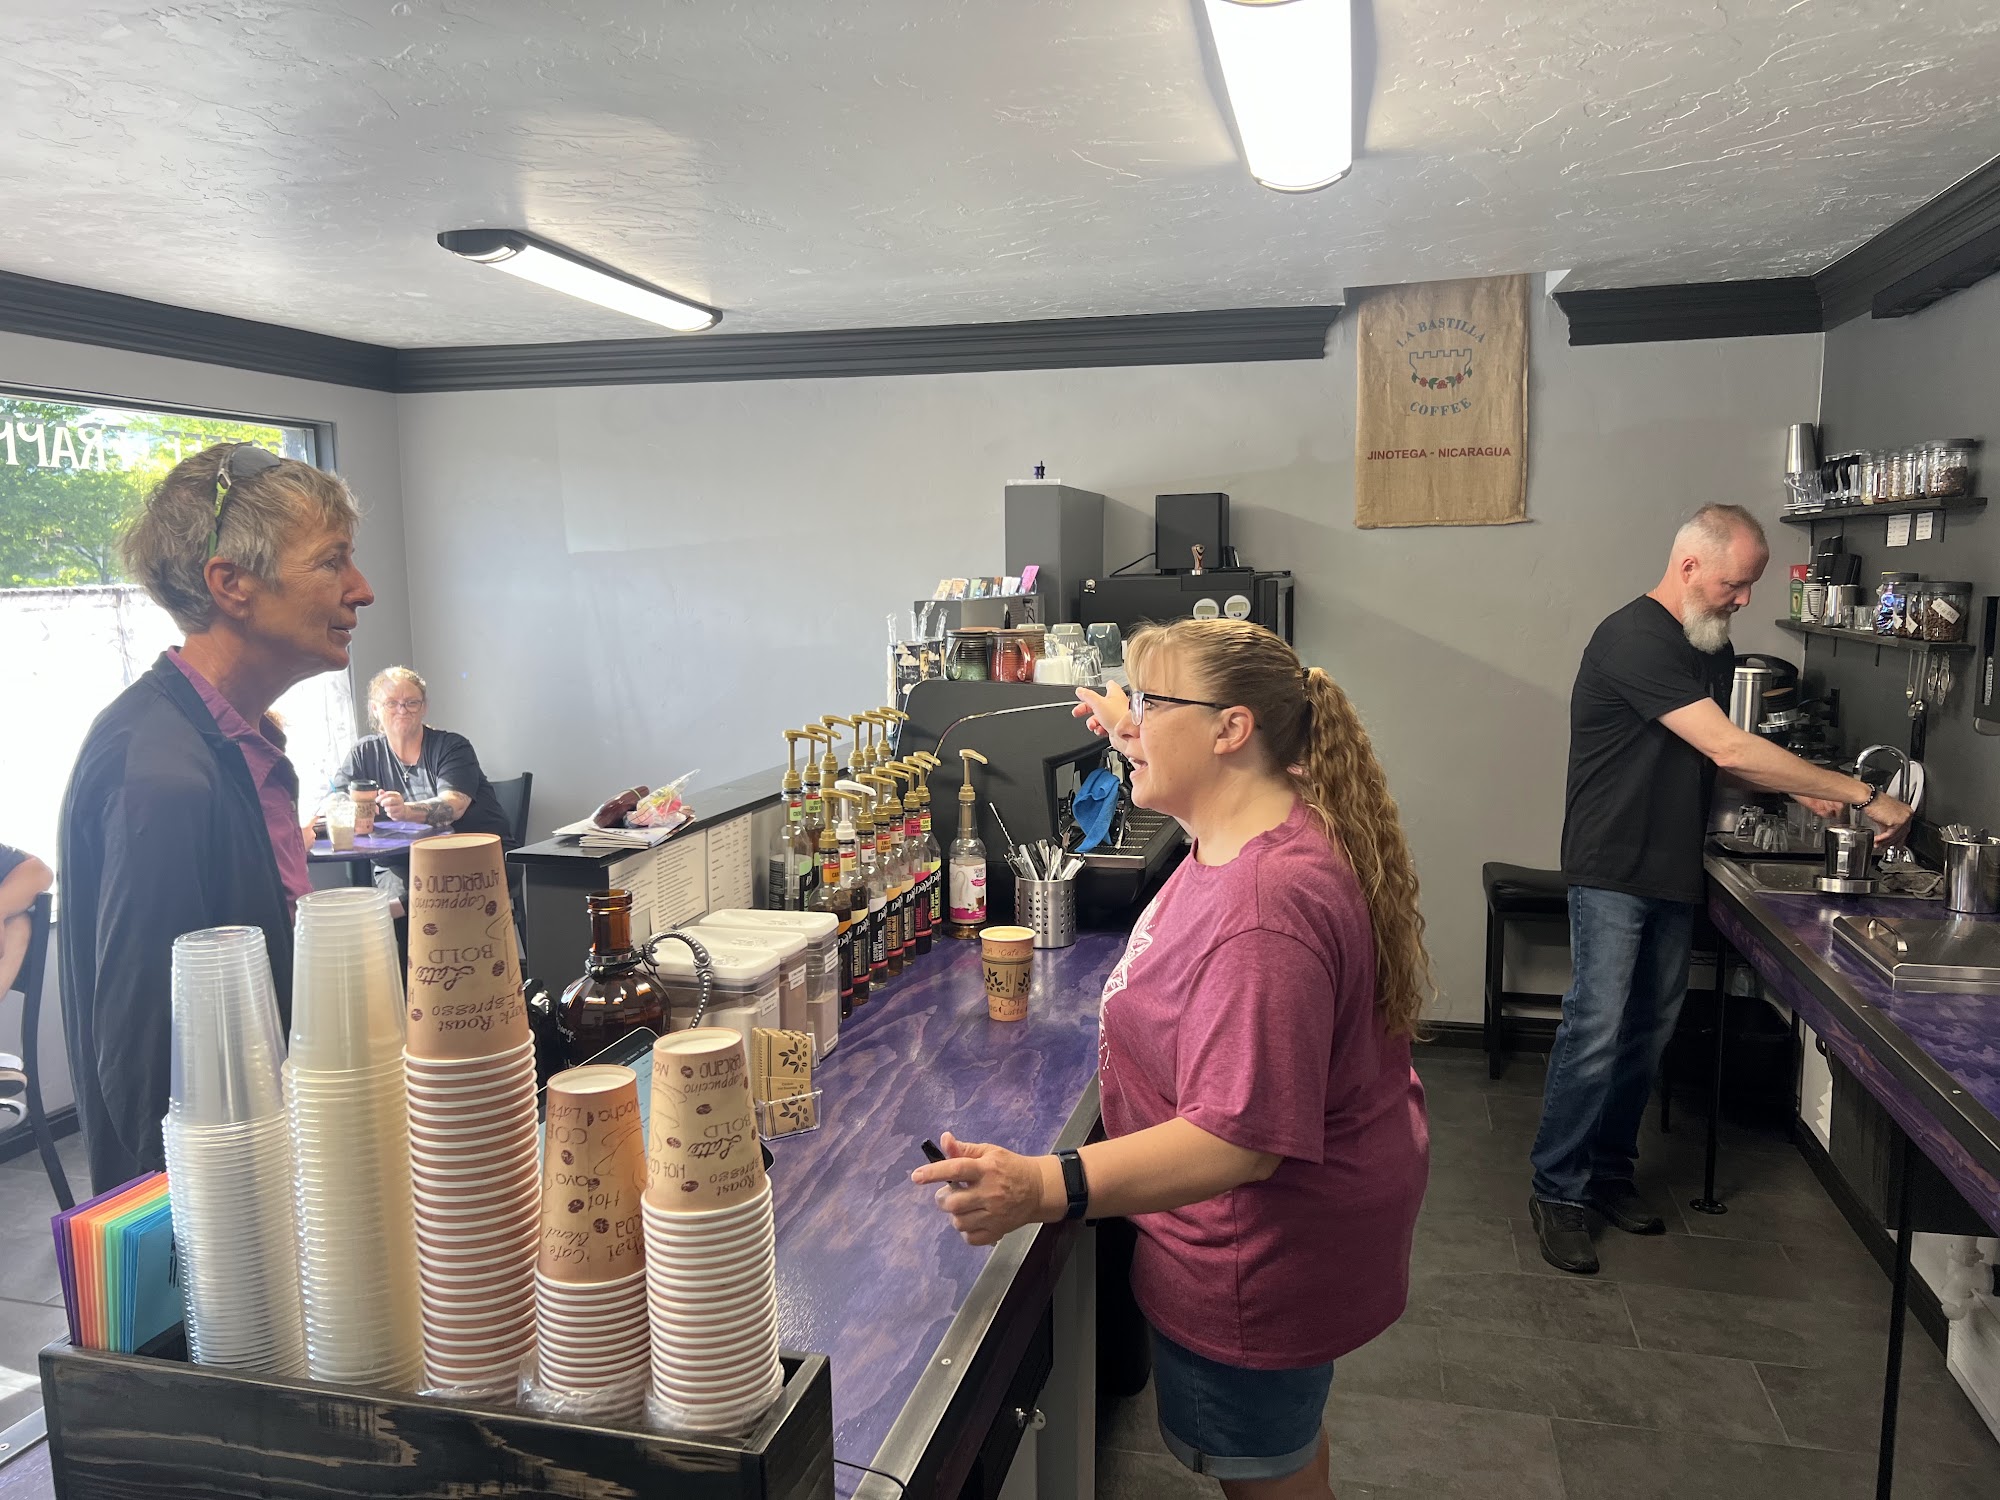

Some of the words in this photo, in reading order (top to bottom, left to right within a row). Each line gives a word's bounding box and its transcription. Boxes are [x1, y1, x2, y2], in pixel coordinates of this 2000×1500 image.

[1396, 329, 1413, 348] LA
[1418, 317, 1486, 345] BASTILLA
[1410, 398, 1472, 416] COFFEE
[1367, 448, 1427, 461] JINOTEGA
[1438, 447, 1511, 458] NICARAGUA
[415, 892, 486, 914] Cappuccino
[428, 943, 494, 965] BOLD
[415, 966, 476, 991] Latte
[432, 993, 516, 1017] Espresso
[437, 1015, 494, 1033] Roast
[703, 1114, 751, 1139] BOLD
[687, 1135, 742, 1161] Latte
[715, 1174, 756, 1197] Roast
[545, 1226, 590, 1247] Blend
[549, 1244, 586, 1265] Cafe
